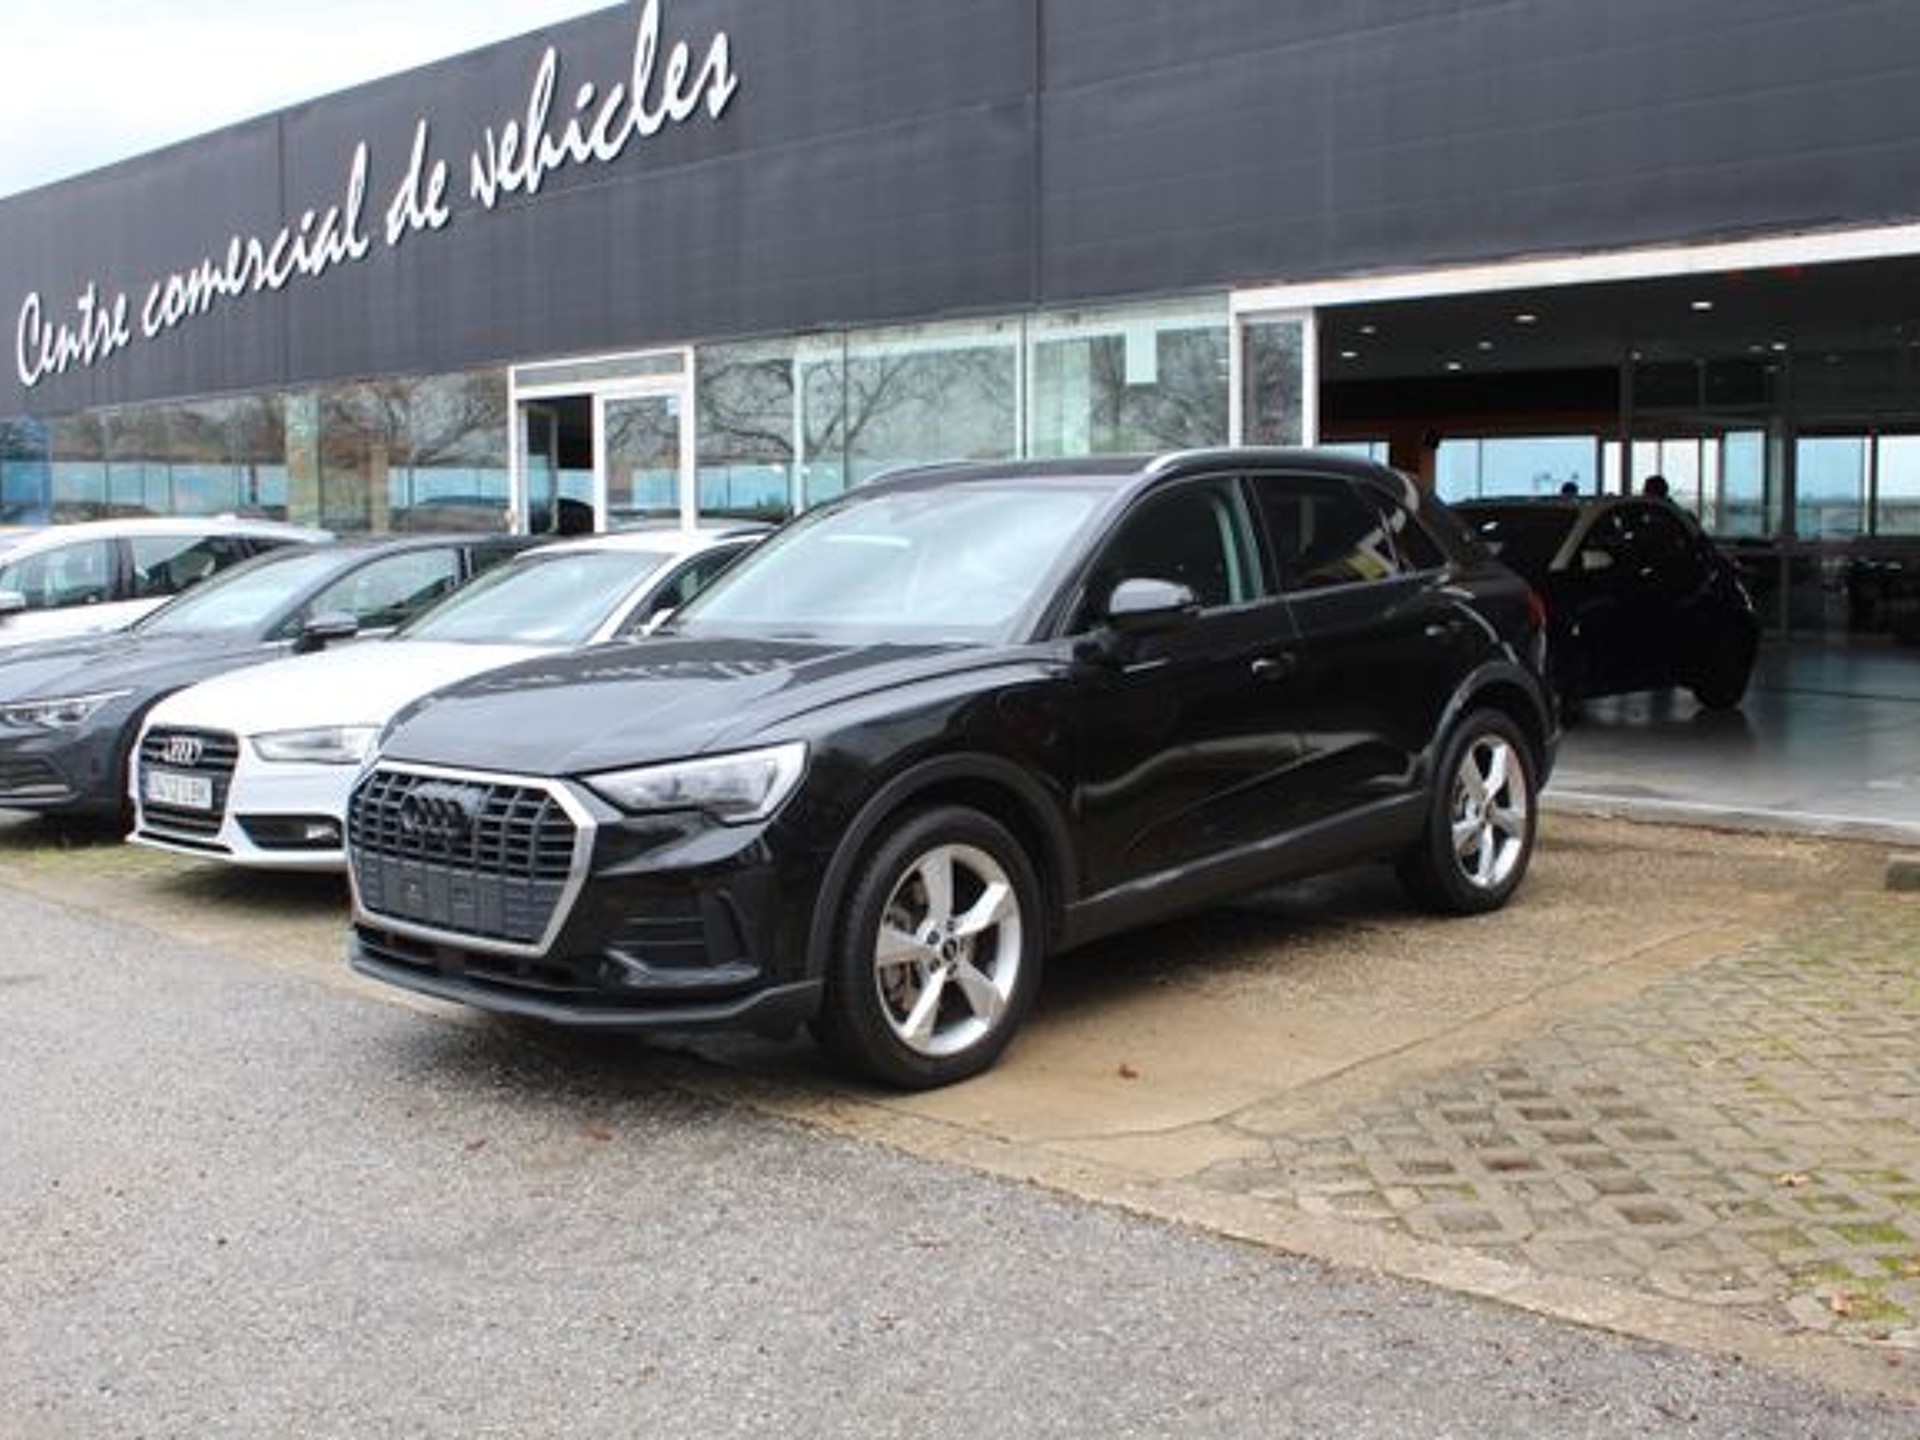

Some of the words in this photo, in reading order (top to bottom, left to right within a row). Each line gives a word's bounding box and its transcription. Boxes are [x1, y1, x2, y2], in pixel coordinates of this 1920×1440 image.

[17, 280, 130, 386] Centre
[142, 140, 369, 336] comercial
[386, 118, 449, 245] de
[471, 0, 737, 208] vehicles
